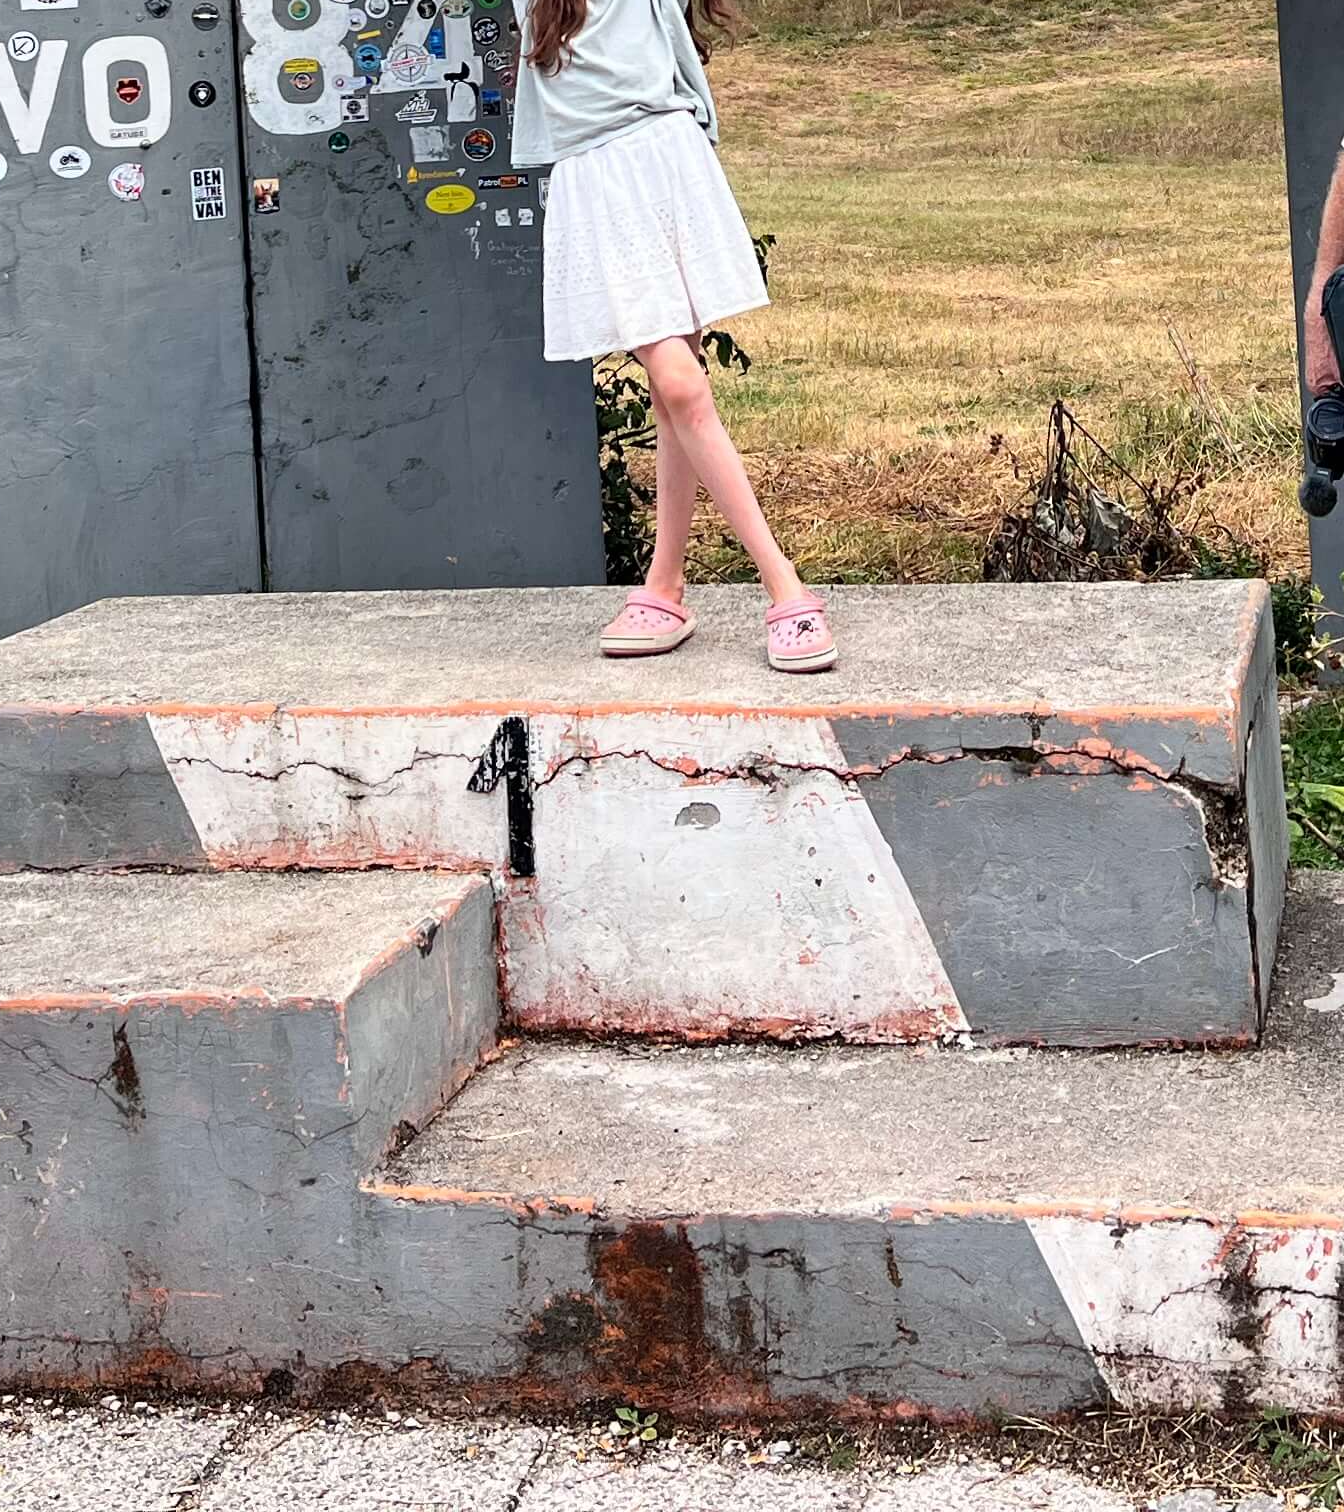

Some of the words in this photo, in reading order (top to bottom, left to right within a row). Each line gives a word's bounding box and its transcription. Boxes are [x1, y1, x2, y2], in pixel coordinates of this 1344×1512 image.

[193, 169, 221, 186] BEN
[206, 186, 222, 196] THE
[196, 201, 224, 219] VAN
[467, 716, 535, 877] 1
